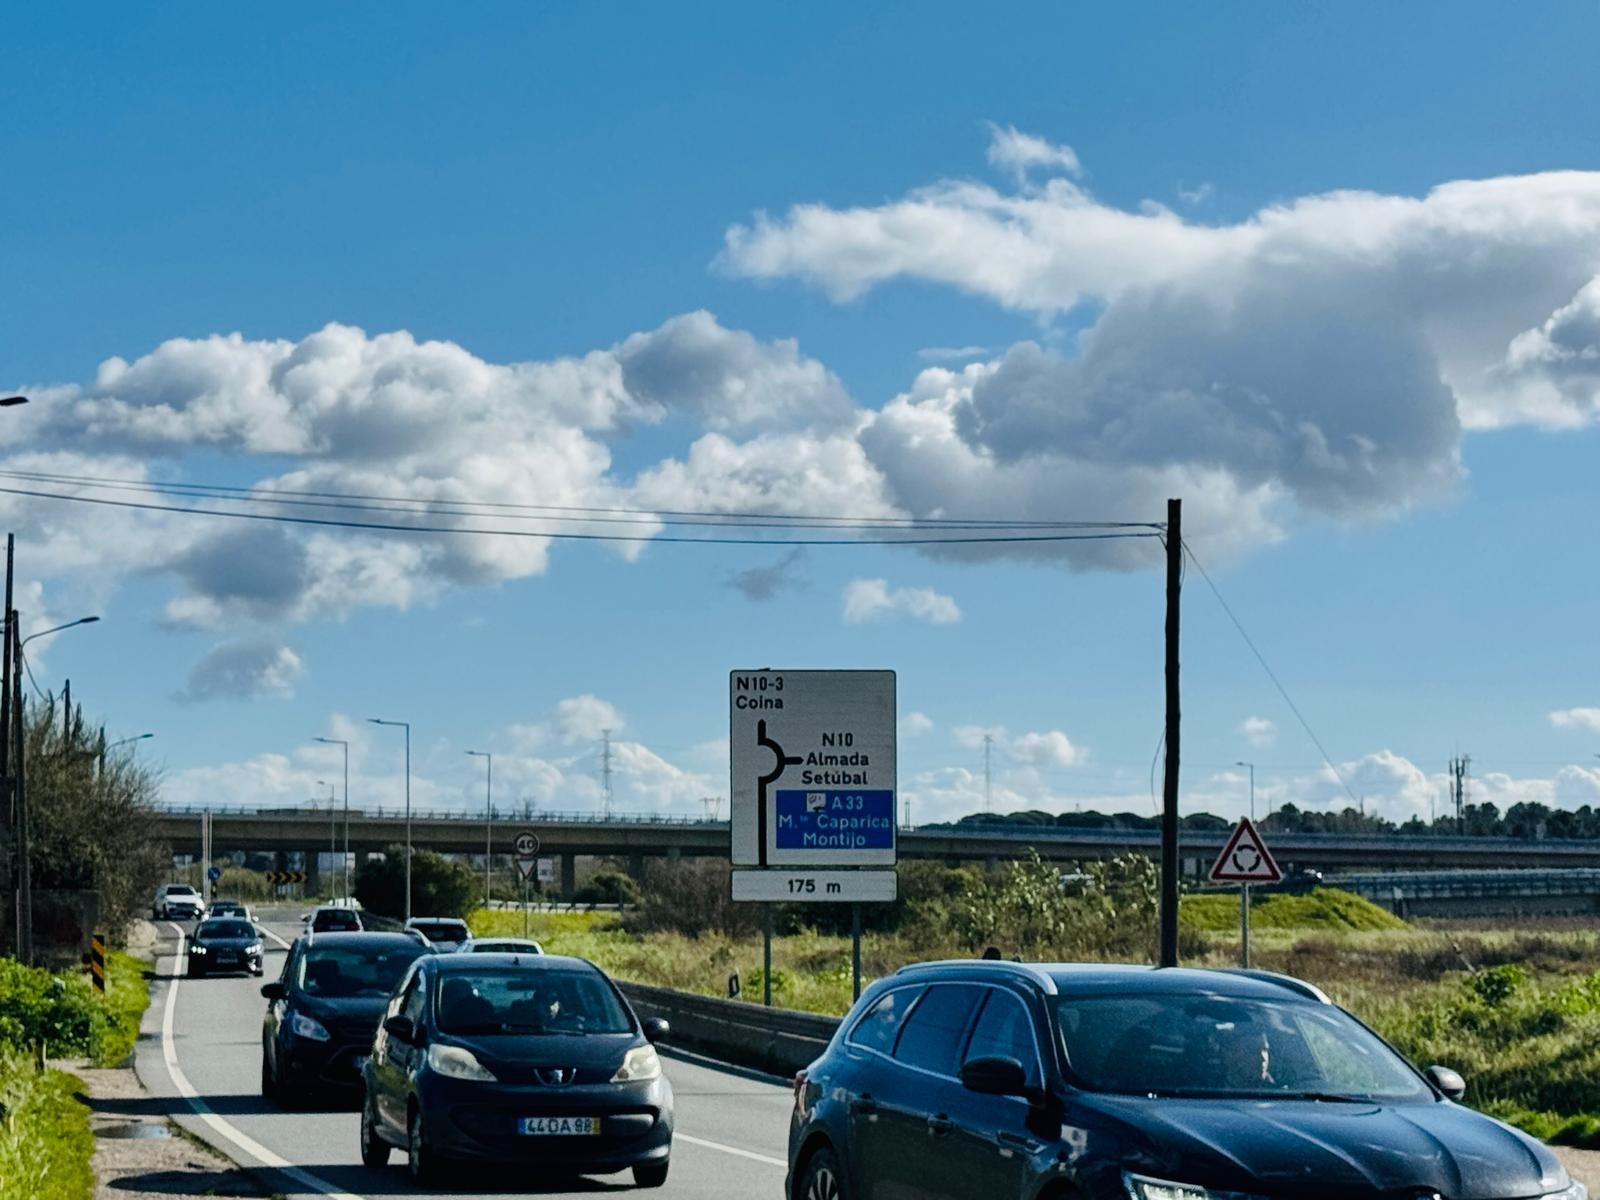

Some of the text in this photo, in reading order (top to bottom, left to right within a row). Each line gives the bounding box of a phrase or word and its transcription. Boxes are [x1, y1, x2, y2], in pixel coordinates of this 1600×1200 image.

[737, 677, 784, 691] N10-3
[736, 695, 784, 710] Coina
[822, 732, 854, 747] N10
[806, 752, 870, 767] Almada
[801, 771, 868, 785] Setúbal
[817, 814, 890, 831] Caparica
[518, 840, 534, 849] 40
[803, 832, 866, 848] Montijo
[788, 880, 841, 893] 175 m
